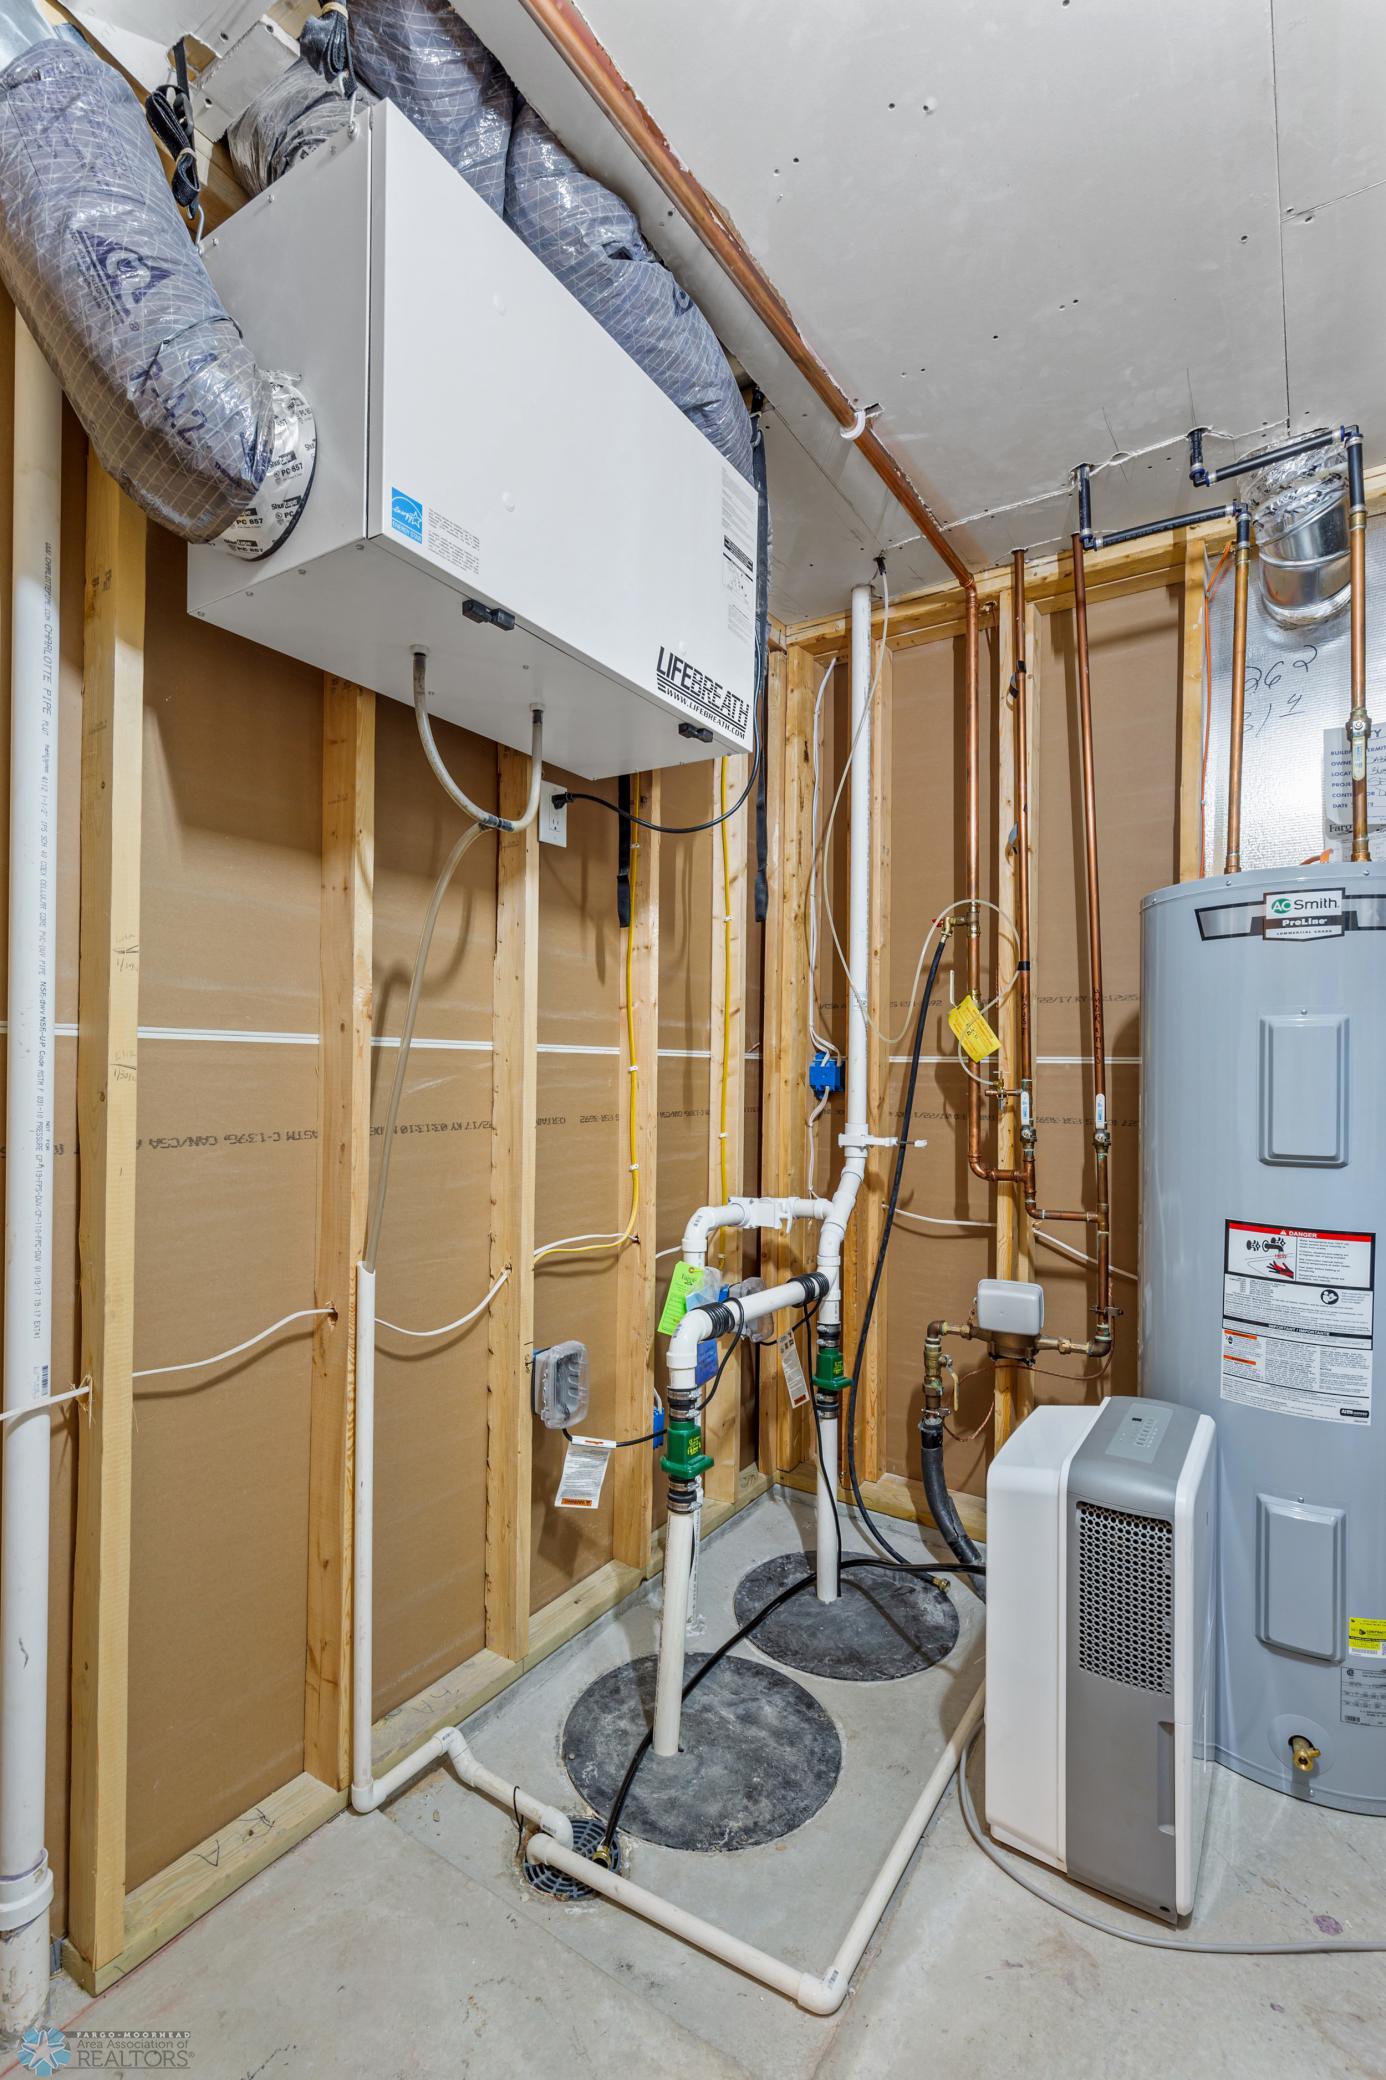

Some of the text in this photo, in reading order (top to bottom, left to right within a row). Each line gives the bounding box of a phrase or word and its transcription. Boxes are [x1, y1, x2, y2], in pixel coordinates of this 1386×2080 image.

[43, 623, 53, 683] CHARLOTTE
[656, 646, 750, 727] LIFEBREATH
[42, 687, 52, 716] PIPE
[666, 687, 746, 740] WWW.LIFEBREATH.COM
[1293, 897, 1339, 910] Smith
[1282, 917, 1328, 927] ProLine
[450, 1122, 463, 1132] KY
[148, 1134, 217, 1149] CAN/CSA
[1288, 1231, 1318, 1239] DANGER
